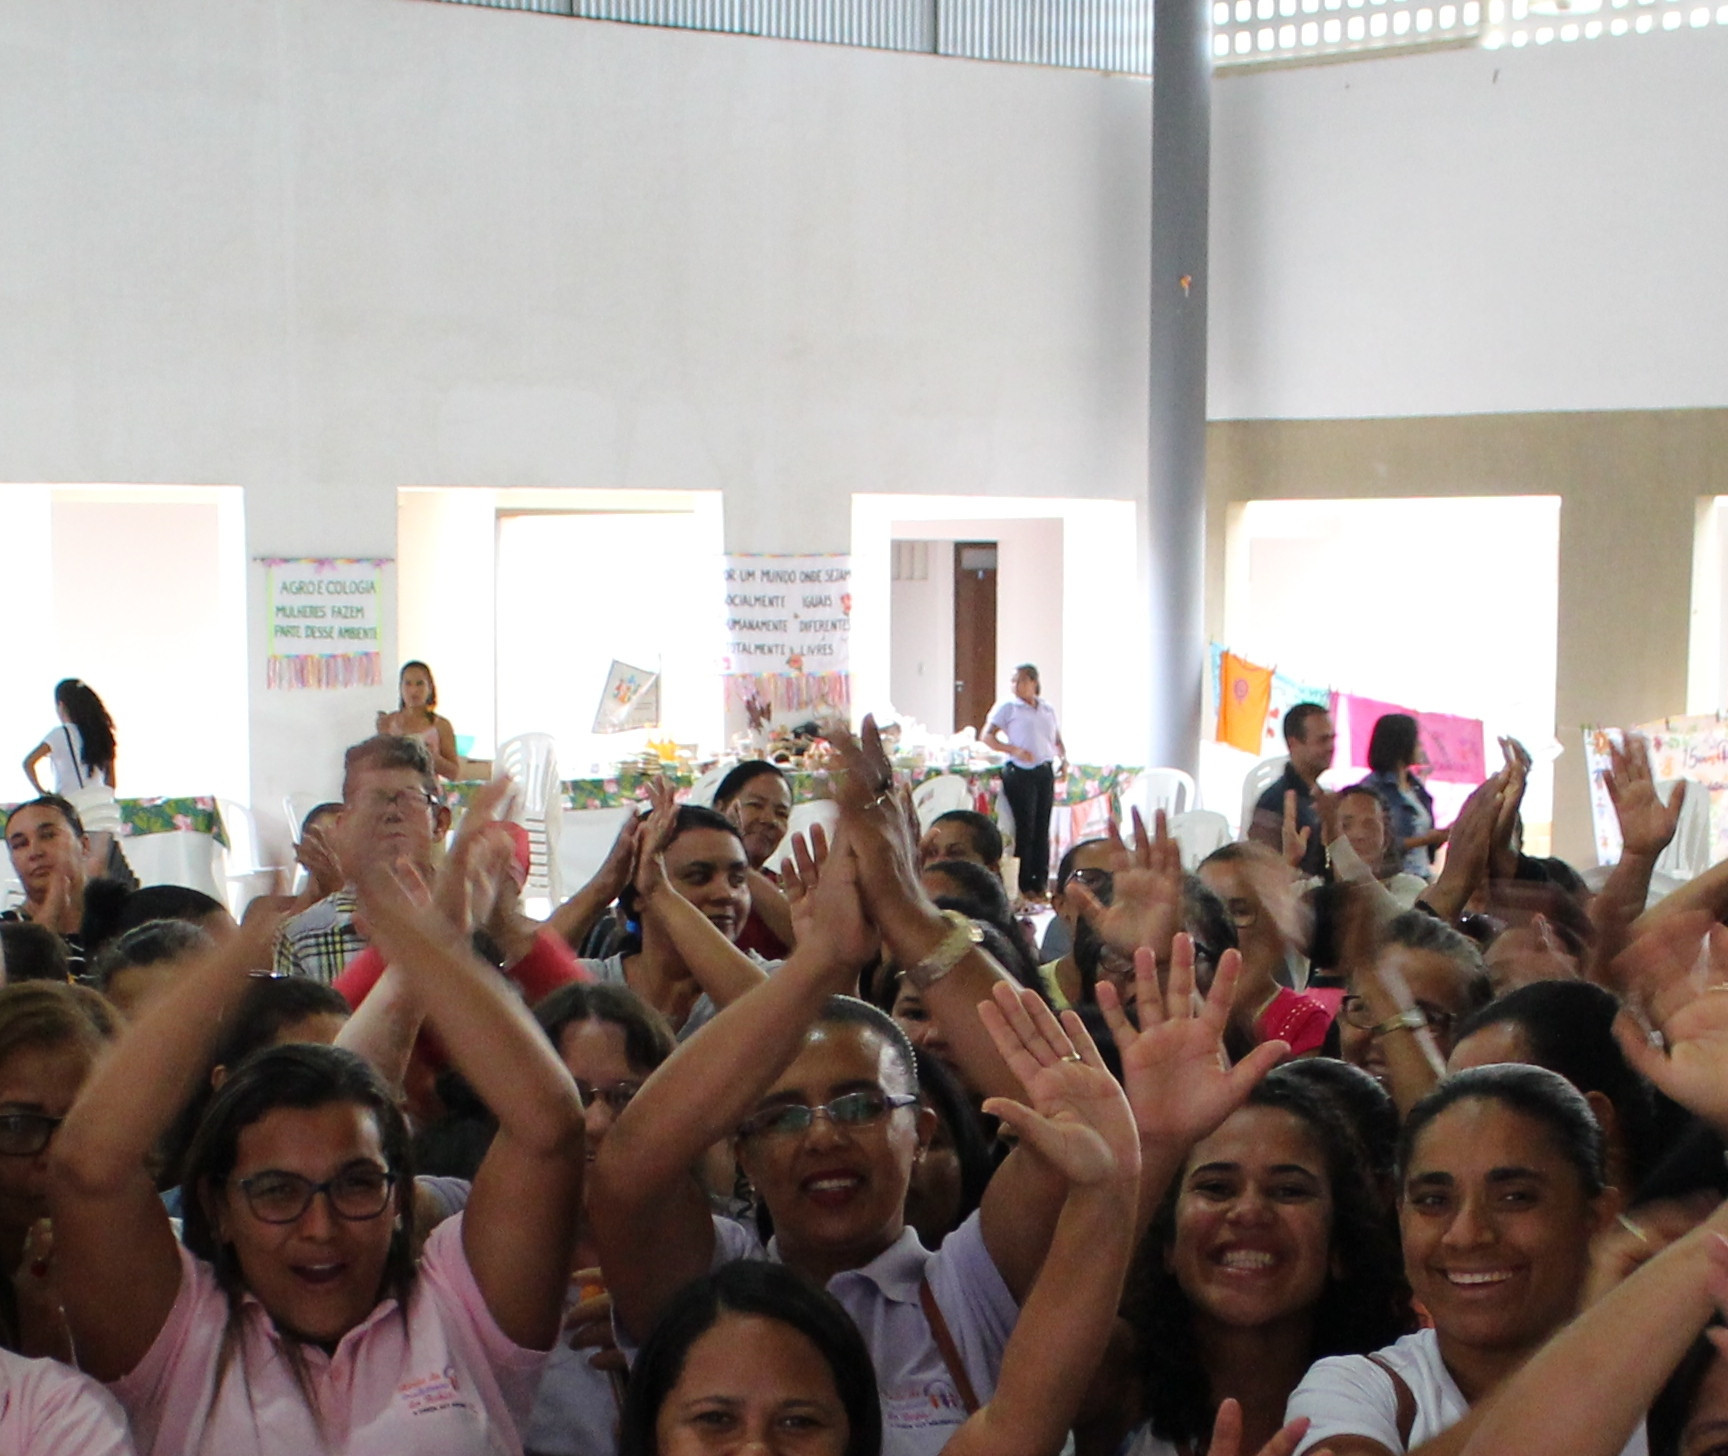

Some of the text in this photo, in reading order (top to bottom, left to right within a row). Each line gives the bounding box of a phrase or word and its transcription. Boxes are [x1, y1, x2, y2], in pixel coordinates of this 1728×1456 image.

[739, 569, 756, 582] UM
[760, 568, 797, 583] MUNDO
[799, 569, 823, 583] ONDE
[725, 594, 833, 608] OCIALMENTE IGUAIS
[275, 604, 365, 619] MULHERES FAZEM
[274, 624, 302, 638] PARTE
[304, 625, 335, 639] DESSE
[726, 618, 789, 632] UMANAMENTE
[800, 643, 834, 656] LIVRES
